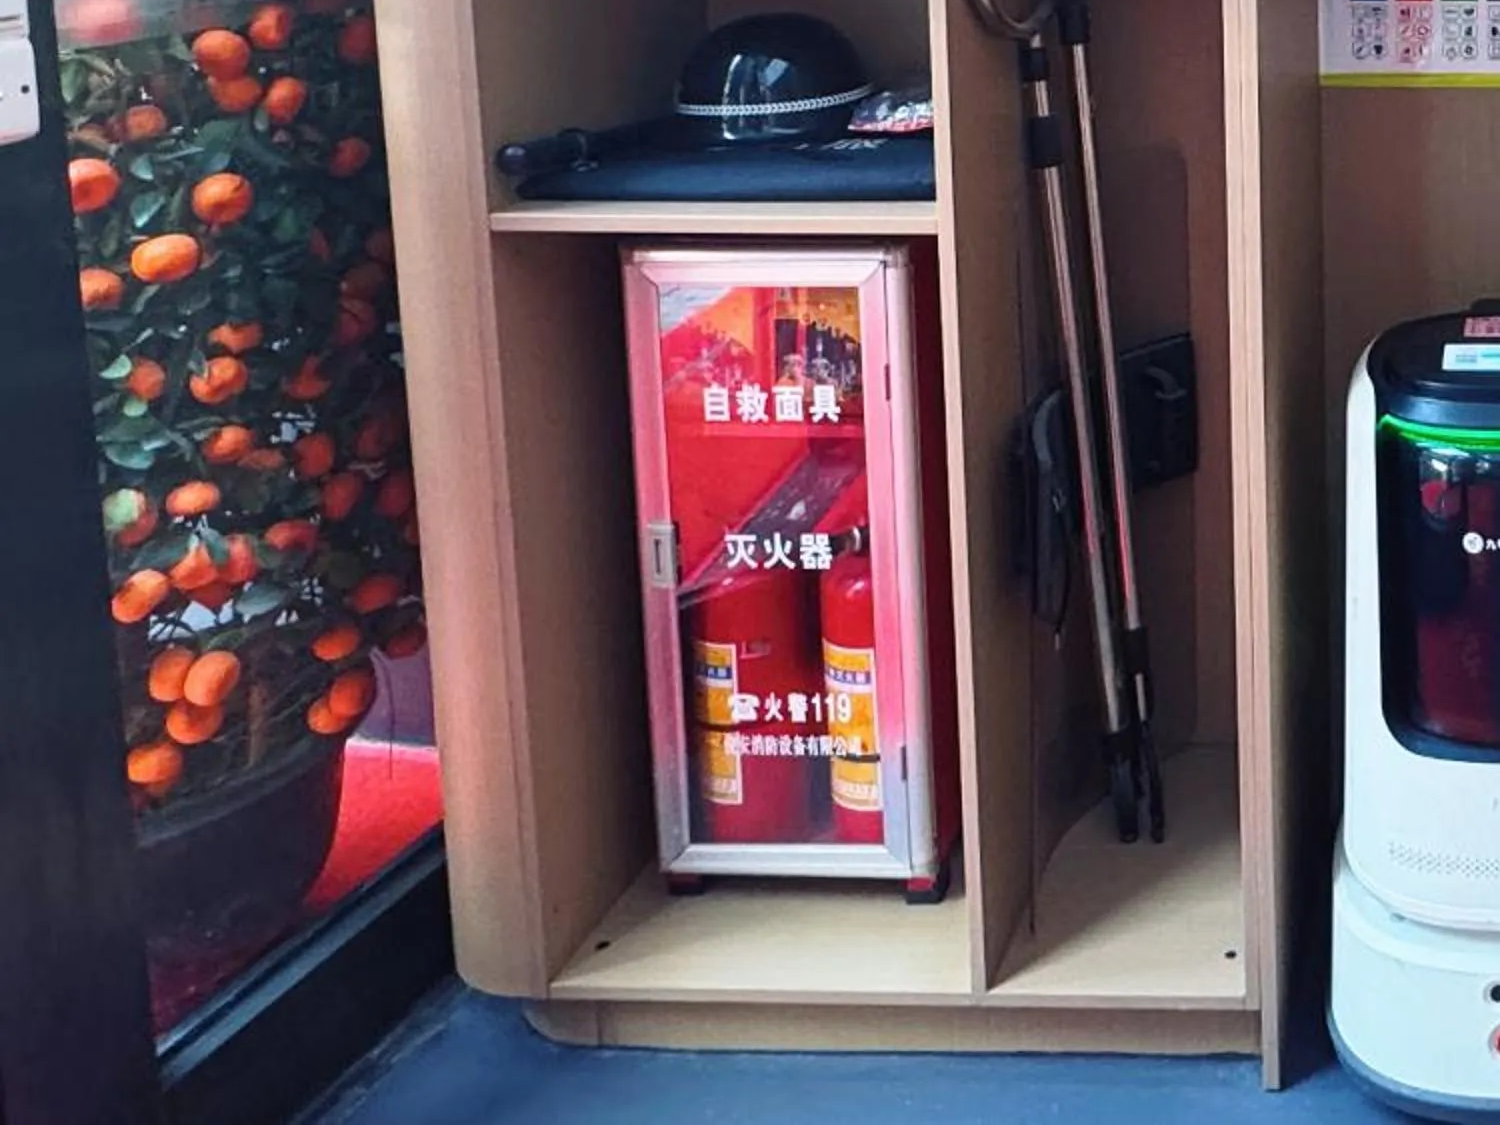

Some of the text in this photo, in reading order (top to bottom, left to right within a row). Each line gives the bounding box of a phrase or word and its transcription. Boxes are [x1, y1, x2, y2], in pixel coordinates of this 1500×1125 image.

[702, 383, 841, 423] 自救面具
[724, 531, 833, 570] 灭火器
[764, 691, 852, 724] 火警119
